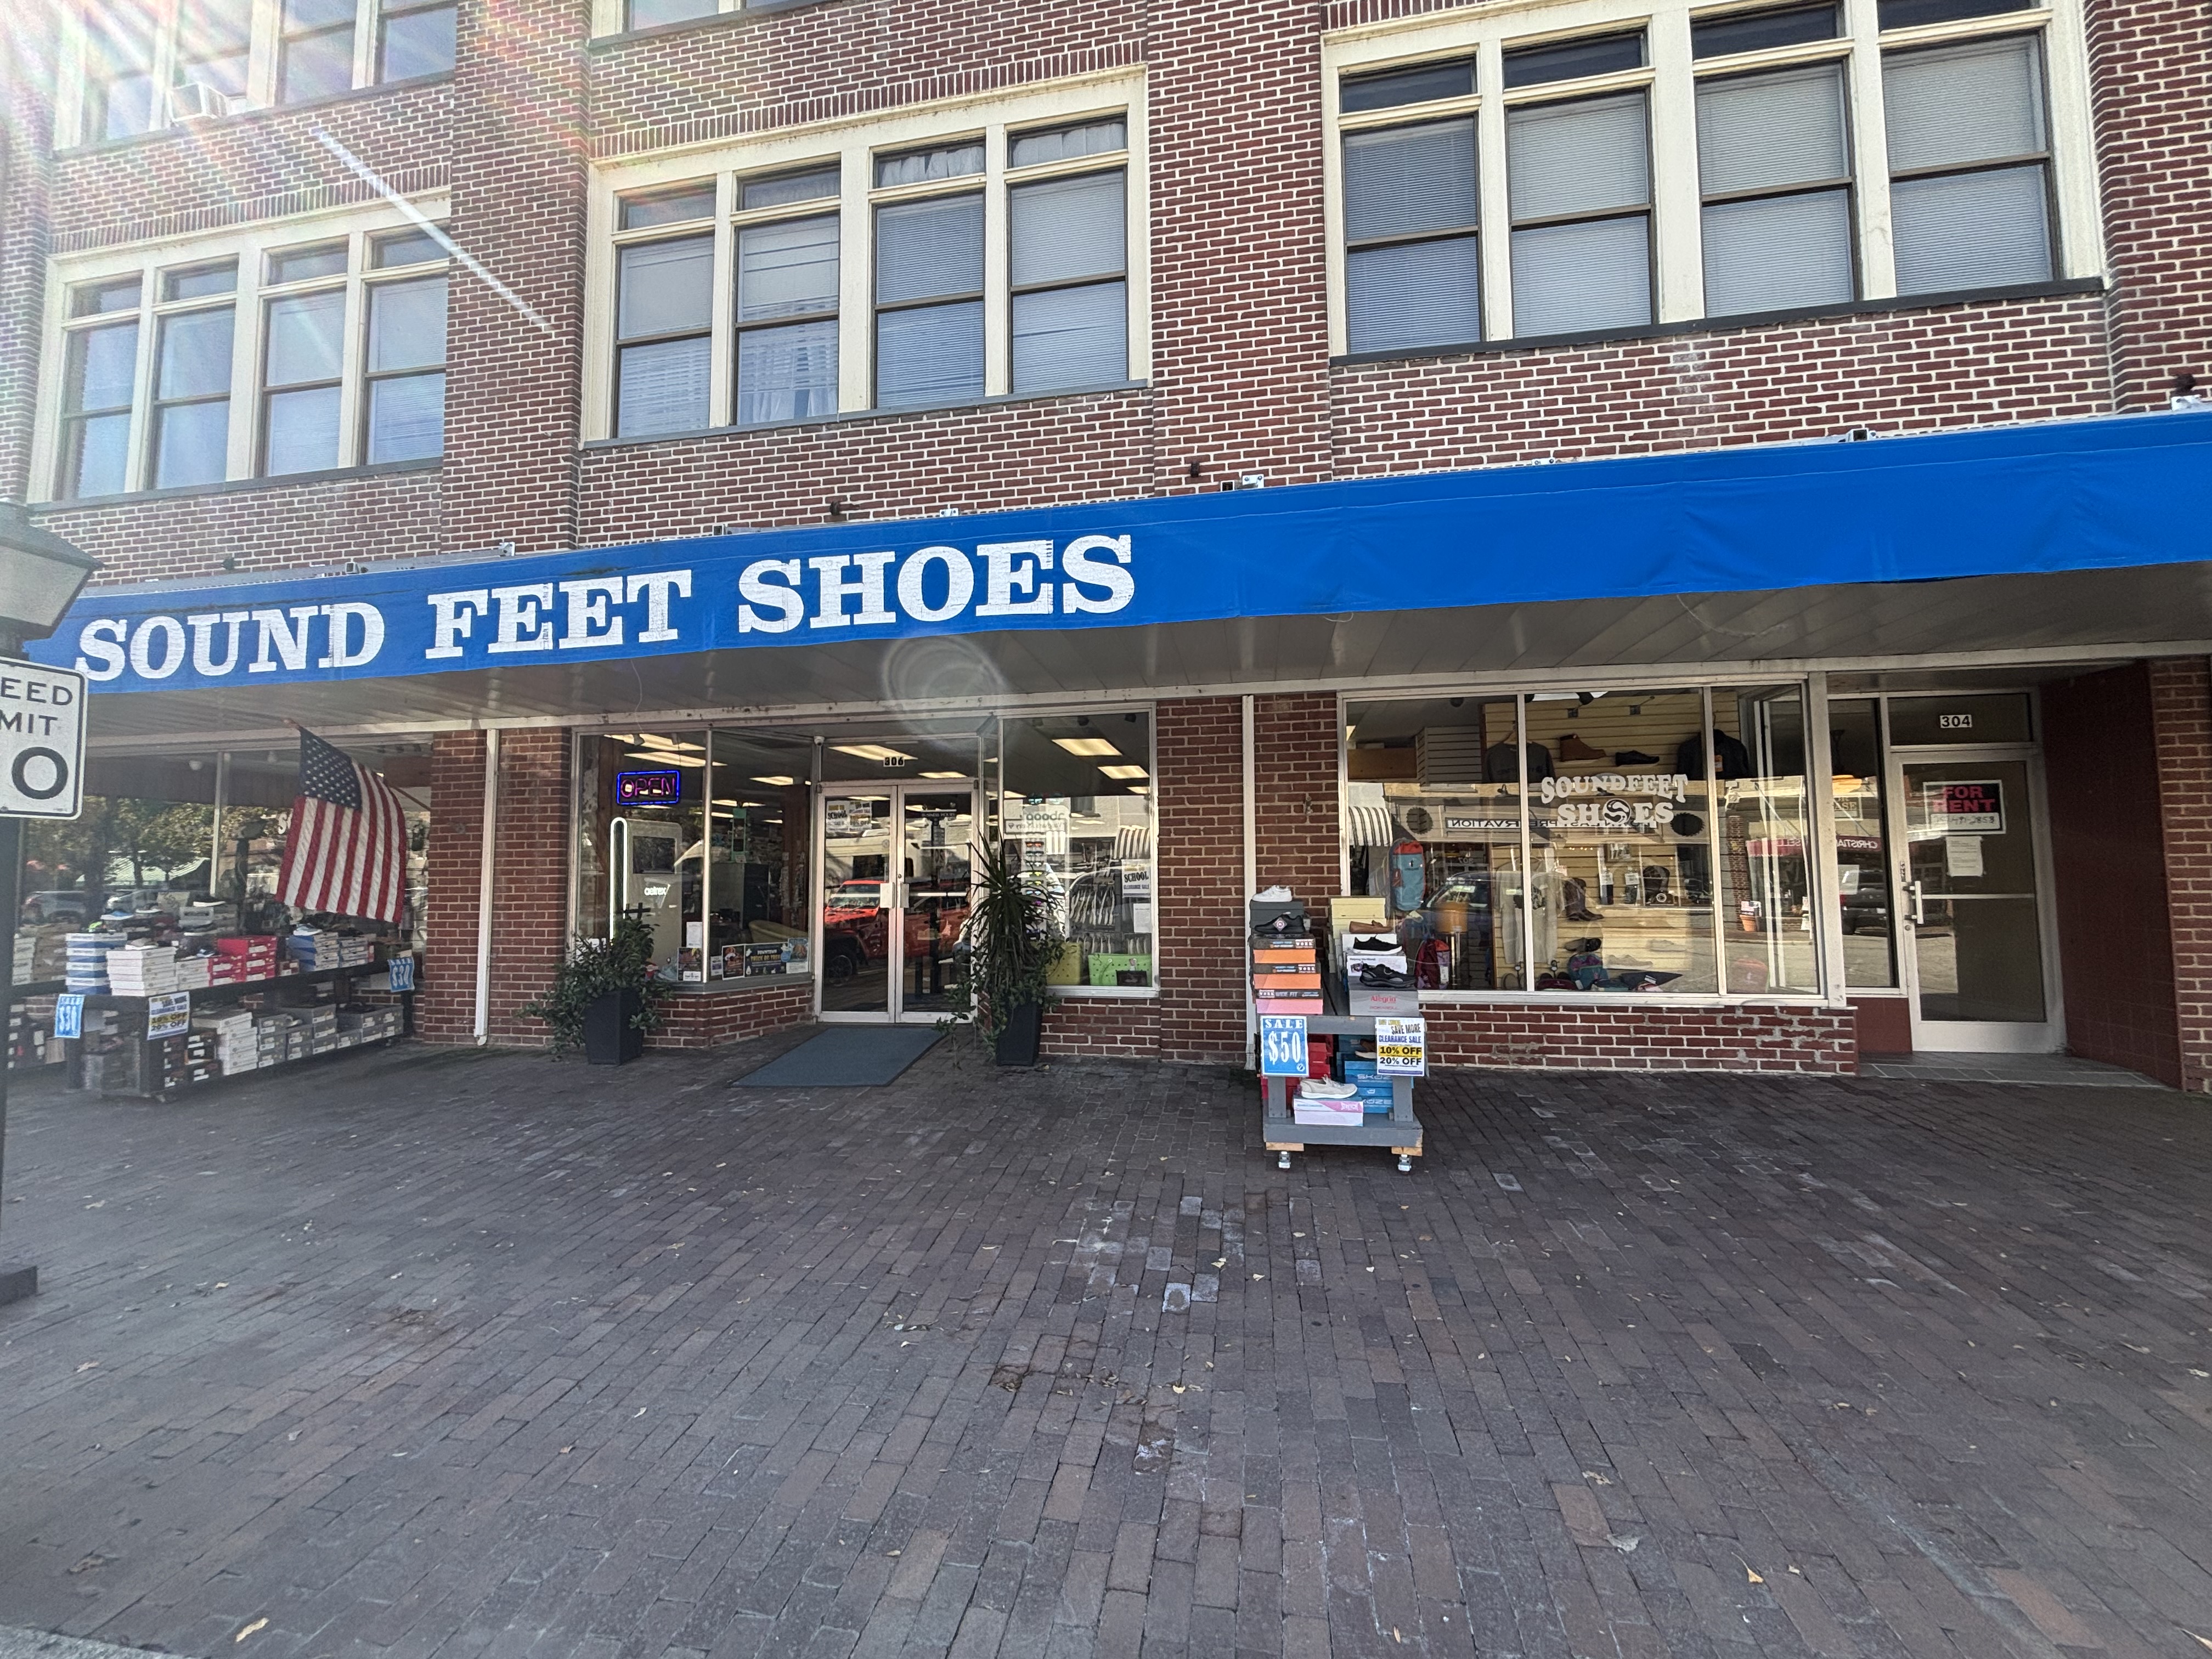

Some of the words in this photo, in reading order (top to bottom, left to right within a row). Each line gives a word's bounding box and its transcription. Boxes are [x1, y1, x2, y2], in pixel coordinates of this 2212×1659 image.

[75, 602, 384, 681] SOUND
[426, 569, 692, 659] FEET
[738, 534, 1135, 633] SHOES
[1, 677, 72, 705] EED
[0, 709, 58, 736] MIT
[1942, 716, 1970, 727] 304
[884, 757, 904, 766] 306
[12, 747, 68, 800] 0
[620, 777, 675, 798] OPEN
[1541, 774, 1688, 804] SOUNDFEET
[1943, 786, 1984, 799] FOR
[1933, 799, 1995, 812] RENT
[828, 810, 848, 820] SCHOOL
[1124, 871, 1149, 883] SCHOOL
[1371, 995, 1396, 1003] Alegria
[1265, 1019, 1303, 1029] SALE
[1391, 1025, 1404, 1035] SAVE
[1406, 1023, 1421, 1034] MORE
[1268, 1031, 1301, 1065] $50
